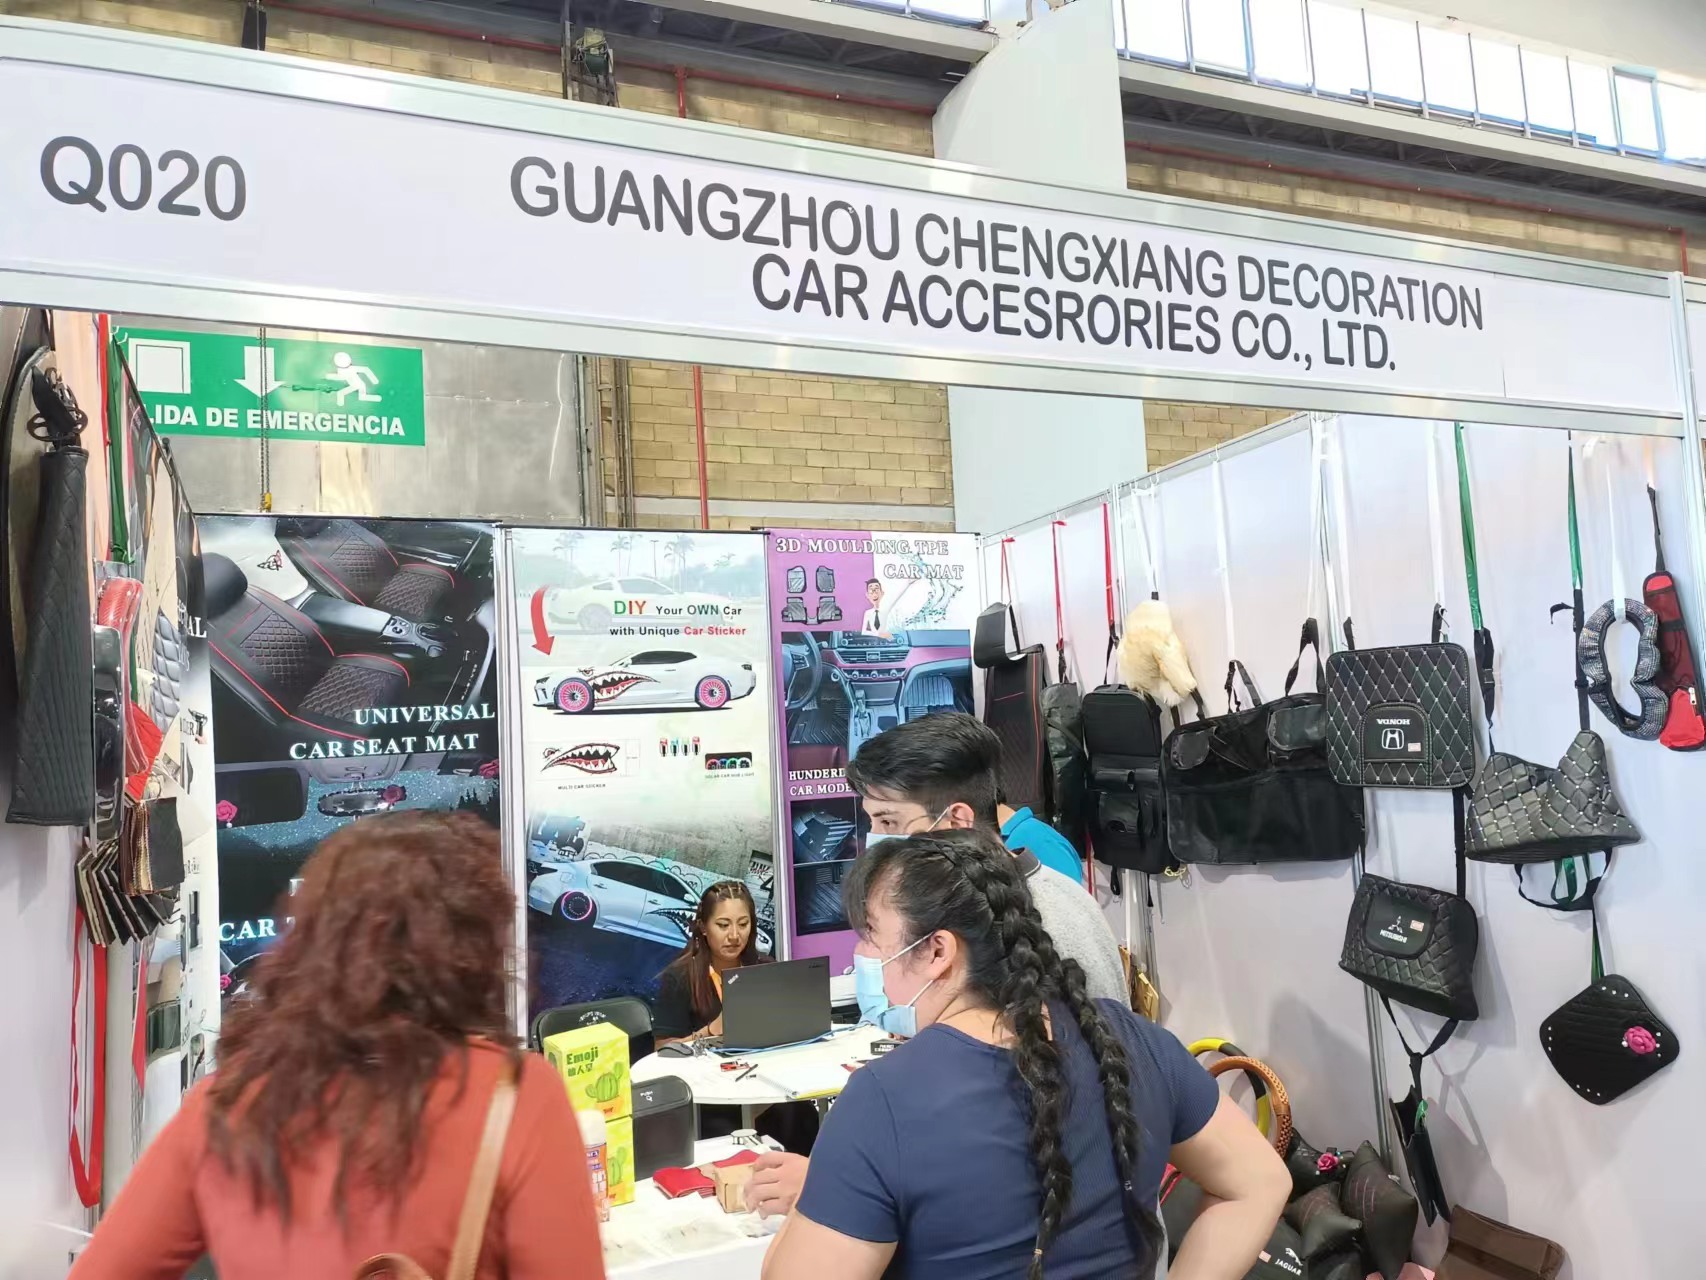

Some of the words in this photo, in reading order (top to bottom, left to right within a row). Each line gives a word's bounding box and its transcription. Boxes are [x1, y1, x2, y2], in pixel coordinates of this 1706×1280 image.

[40, 135, 247, 221] Q020
[510, 156, 900, 261] GUANGZHOU
[916, 212, 1227, 298] CHENGXIANG
[1237, 254, 1484, 330] DECORATION
[752, 253, 869, 321] CAR
[882, 269, 1221, 355] ACCESRORIES
[1232, 312, 1312, 371] CO.,
[1323, 317, 1396, 371] LTD.
[149, 404, 198, 426] IDA
[206, 407, 238, 428] DE
[246, 408, 405, 436] EMERGENCIA
[776, 538, 801, 553] 3D
[808, 538, 911, 555] MOULDING
[914, 540, 949, 556] TPE
[883, 564, 922, 580] CAR
[925, 564, 964, 580] MAT
[614, 600, 647, 615] DIY
[656, 605, 683, 616] Your
[687, 604, 719, 616] OWN
[723, 605, 742, 616] Car
[609, 626, 635, 636] with
[639, 626, 680, 638] Unique
[684, 626, 704, 636] Car
[707, 625, 747, 636] Sticker
[354, 702, 496, 725] UNIVERSAL
[289, 741, 345, 760] CAR
[353, 736, 417, 756] SEAT
[425, 733, 479, 752] MAT
[790, 784, 813, 796] CAR
[817, 782, 853, 794] MODE
[219, 917, 276, 942] CAR
[566, 1045, 599, 1065] Emoji
[1274, 1258, 1302, 1276] JAGUAR
